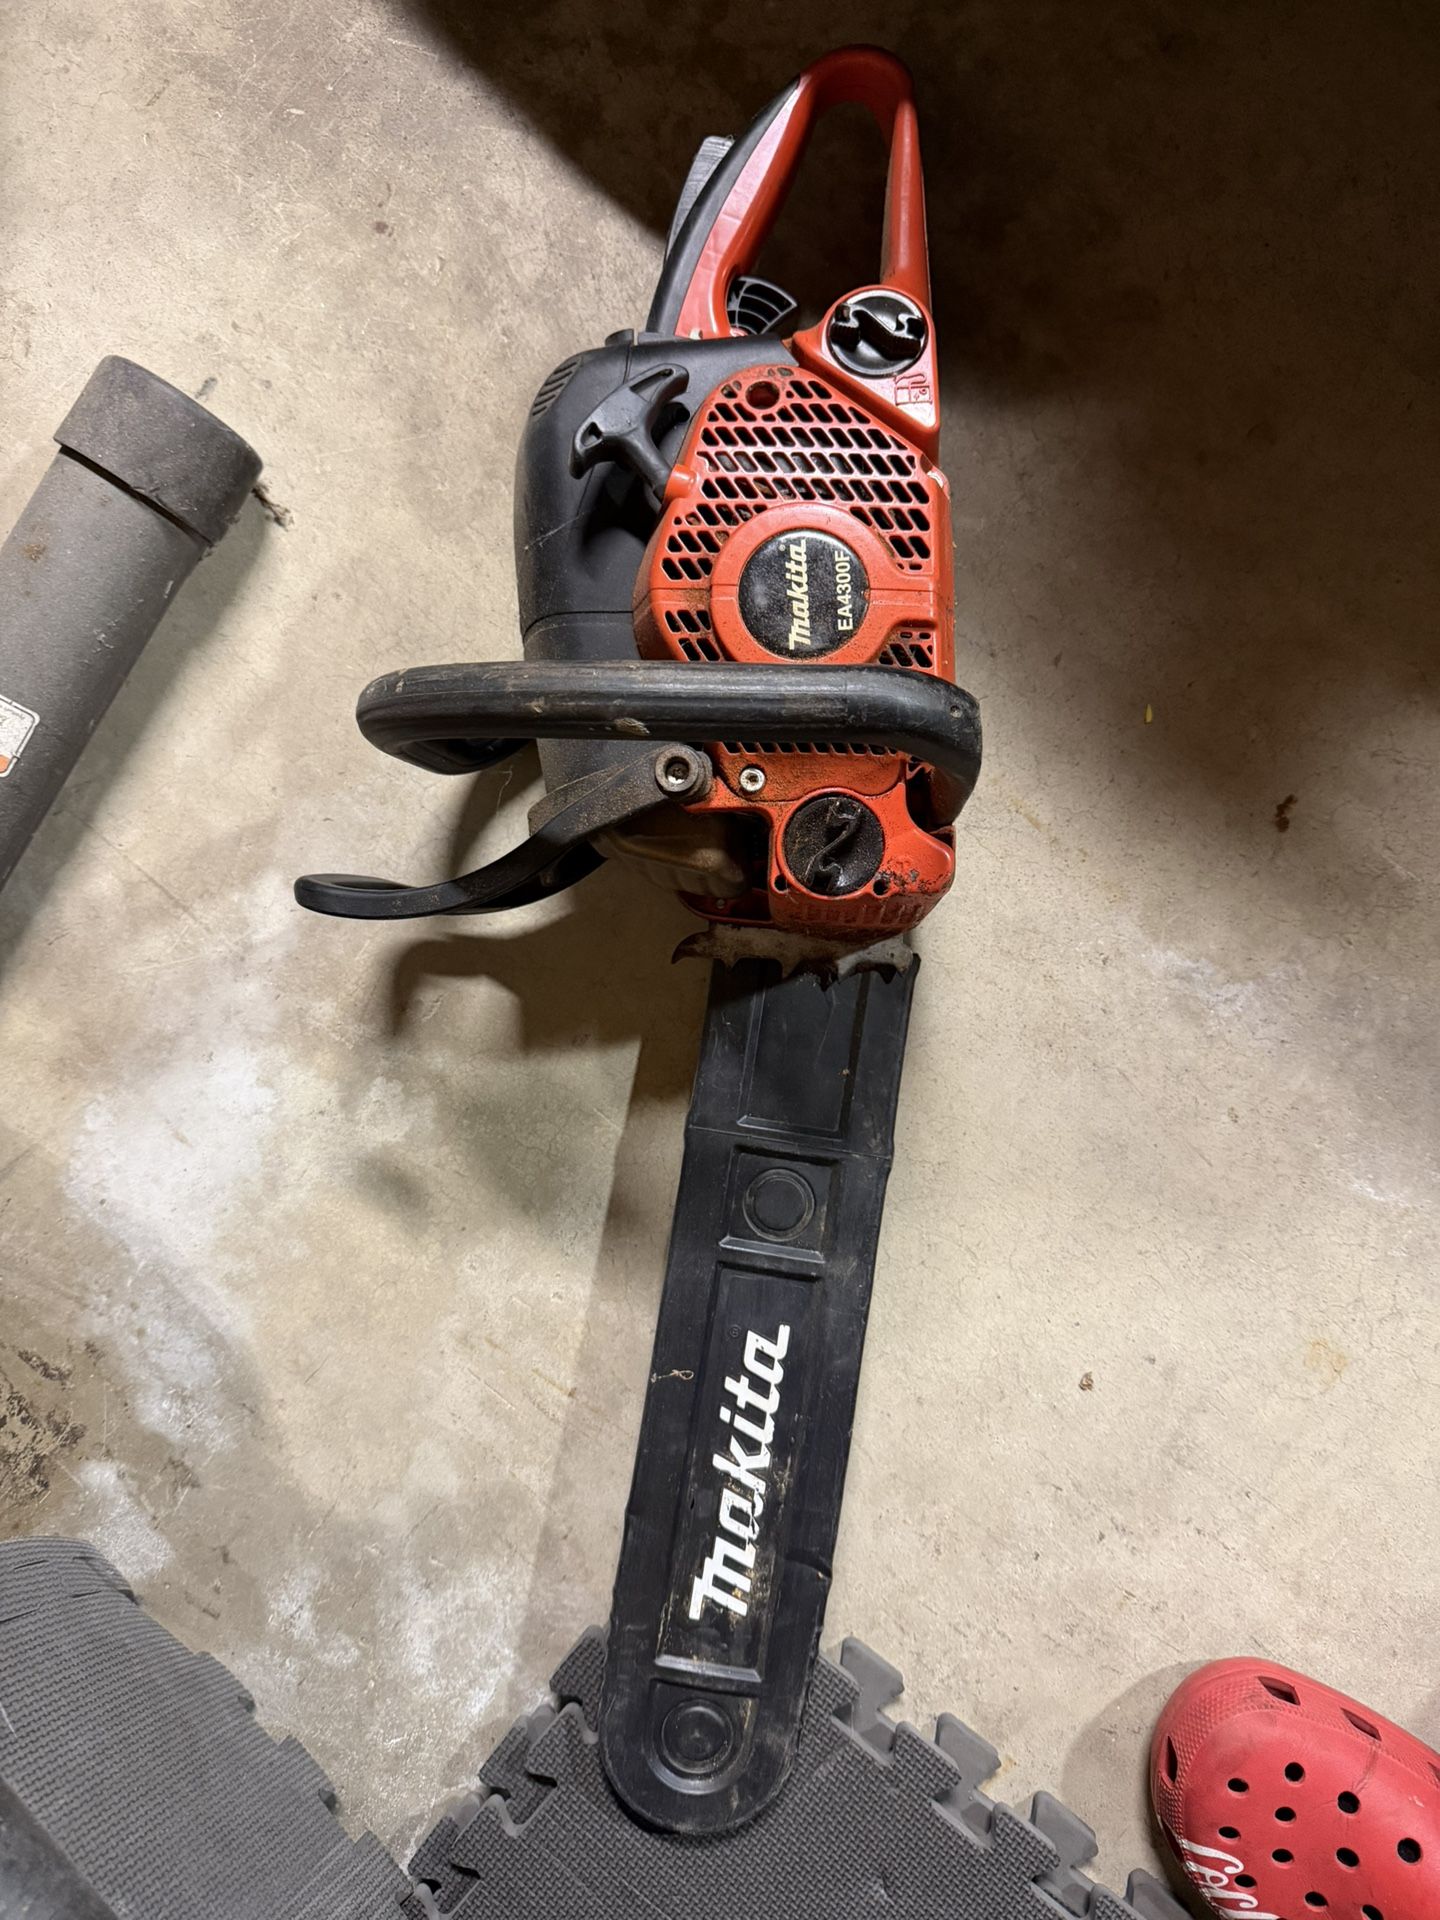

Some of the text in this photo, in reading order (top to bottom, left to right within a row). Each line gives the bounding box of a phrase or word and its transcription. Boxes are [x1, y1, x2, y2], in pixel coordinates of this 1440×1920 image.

[785, 539, 811, 650] makita
[834, 550, 853, 631] EA4300F
[688, 1324, 790, 1620] makita
